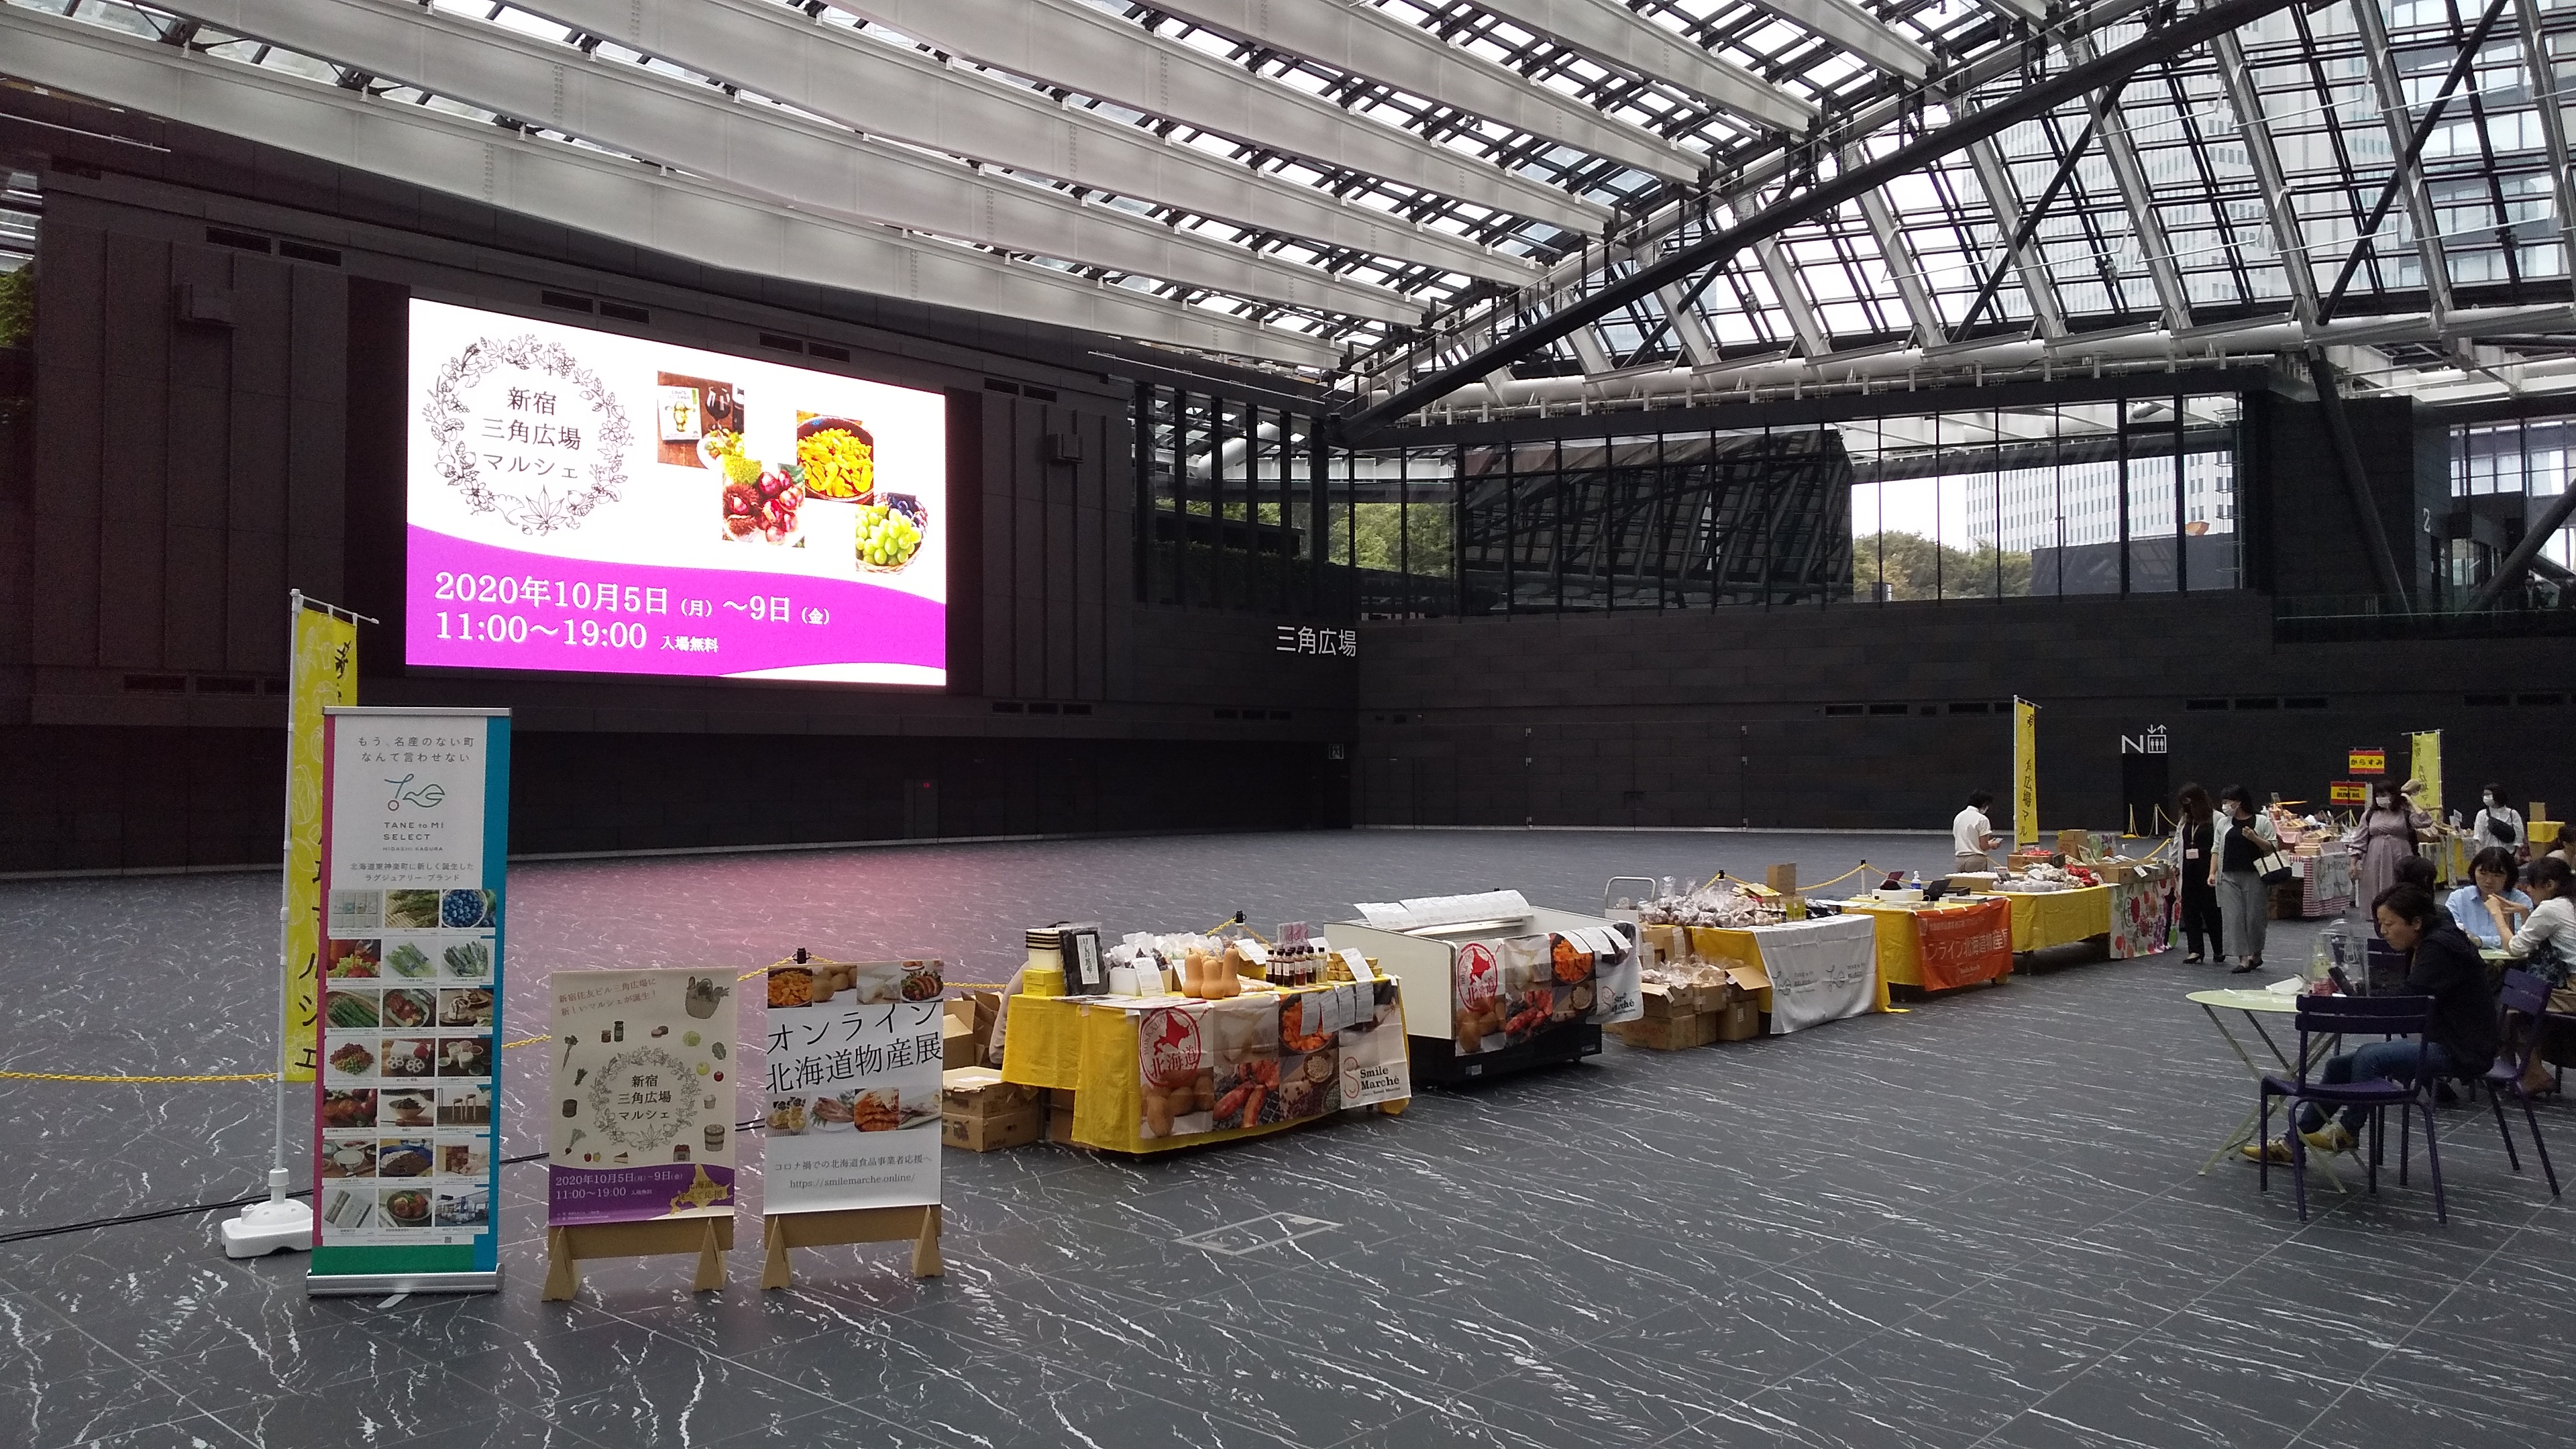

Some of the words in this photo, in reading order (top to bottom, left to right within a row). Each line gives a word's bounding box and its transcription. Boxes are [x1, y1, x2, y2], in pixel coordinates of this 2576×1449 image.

[507, 386, 556, 415] 新宿
[482, 419, 581, 450] 三角広場
[483, 455, 578, 478] マルシェ
[2423, 508, 2430, 532] 2
[660, 635, 718, 653] 入場無料
[1277, 626, 1356, 657] 三角広場
[359, 737, 474, 747] もう、名産のない町
[2122, 735, 2144, 753] N
[362, 752, 470, 762] なんて言わせない
[767, 1003, 937, 1055] オンライン
[766, 1032, 943, 1093] 北海道物産展
[1150, 1044, 1199, 1077] 北海道
[632, 1074, 658, 1087] 新宿
[1360, 1066, 1389, 1079] Smile
[1361, 1075, 1400, 1091] Marché
[618, 1091, 672, 1104] 三角広場
[619, 1110, 669, 1120] マルシェ
[775, 1154, 932, 1171] コロナ禍での北海道食品事業者応援へ
[790, 1173, 915, 1189] https://smilemarche.online/
